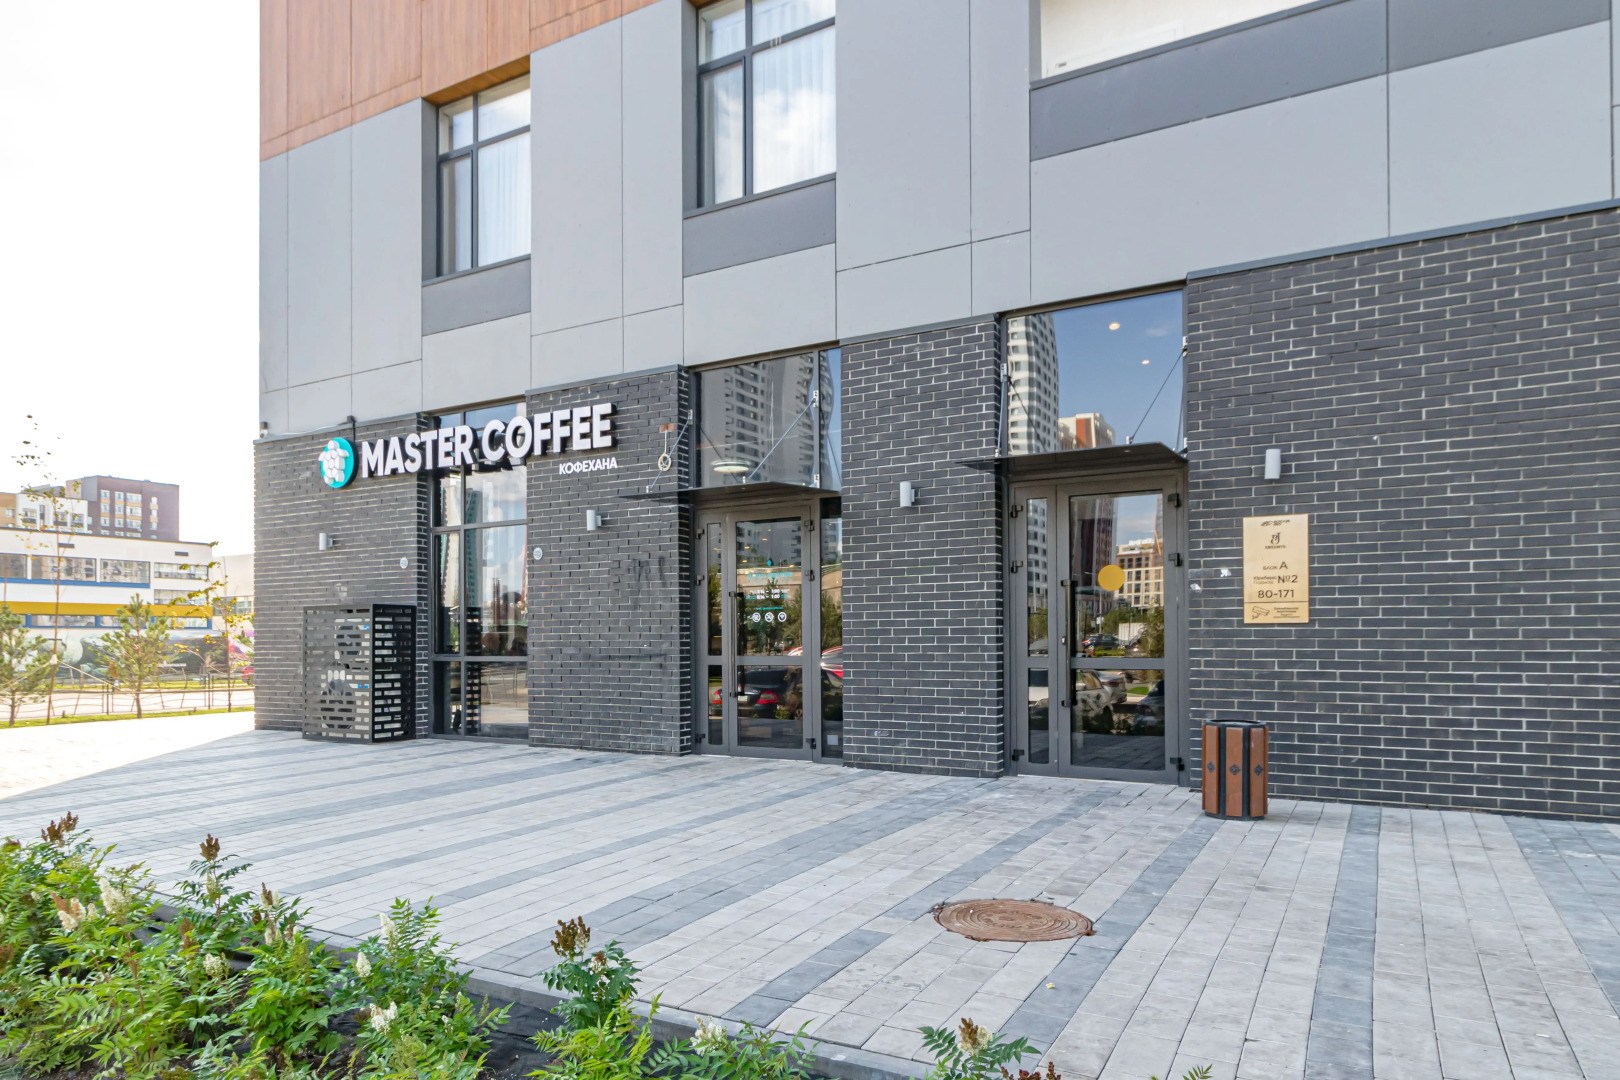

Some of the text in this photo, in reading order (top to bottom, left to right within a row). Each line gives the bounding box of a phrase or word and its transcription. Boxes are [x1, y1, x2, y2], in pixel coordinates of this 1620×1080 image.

[361, 402, 612, 478] MASTER COFFEE
[558, 457, 618, 475] КОФЕХАНА
[1257, 589, 1295, 599] 80-171
